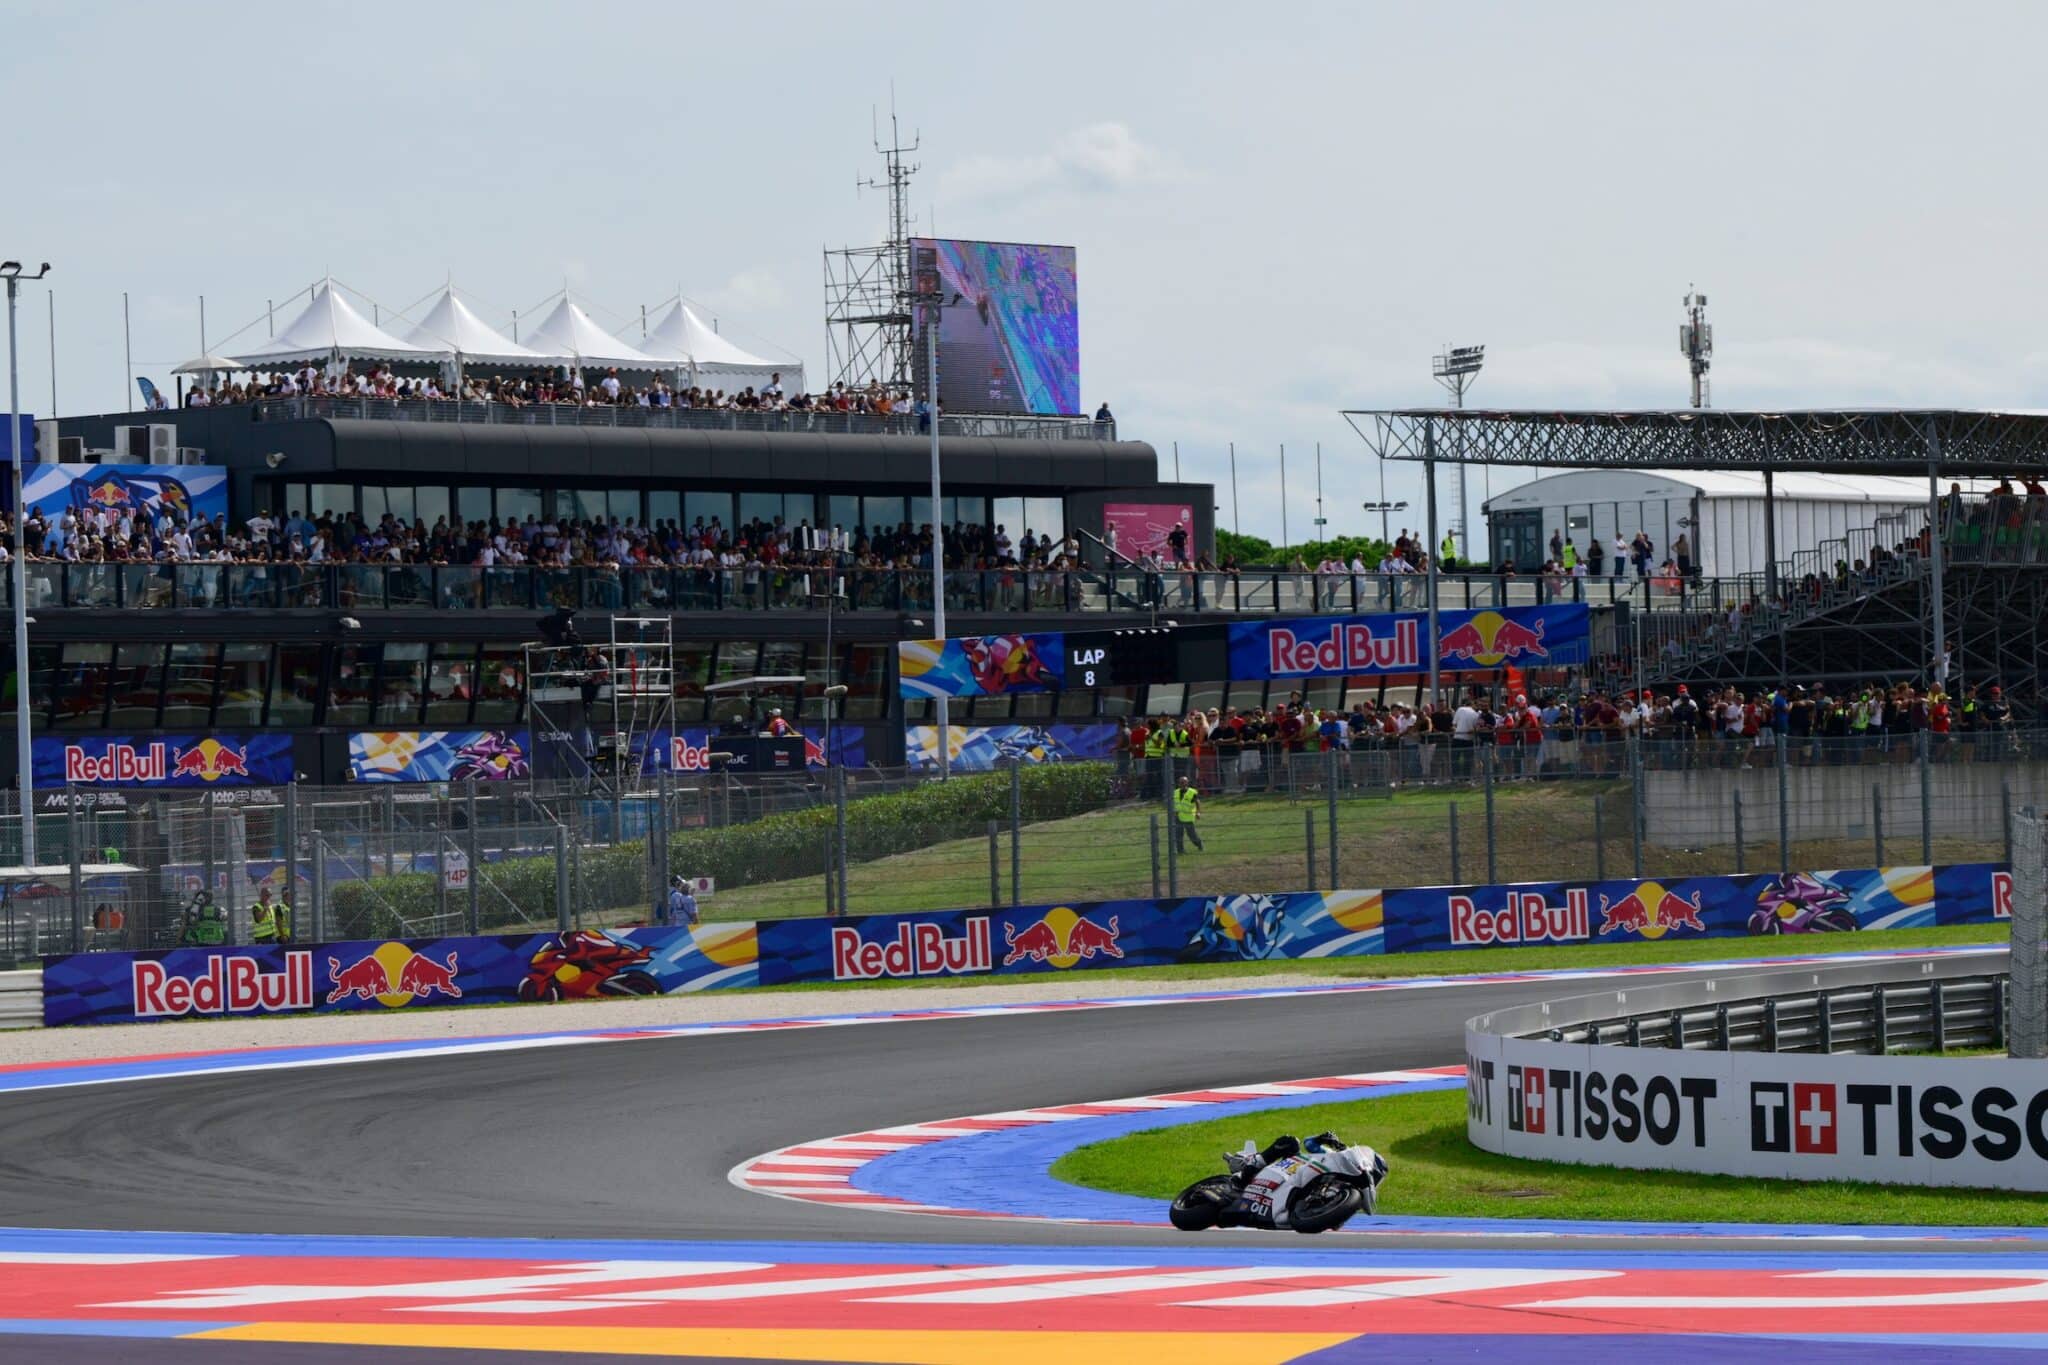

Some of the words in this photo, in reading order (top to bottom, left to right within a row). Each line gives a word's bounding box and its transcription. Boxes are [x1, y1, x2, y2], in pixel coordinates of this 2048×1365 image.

[1073, 649, 1105, 665] LAP
[1270, 623, 1344, 673] Red
[1346, 619, 1418, 669] Bull
[1084, 670, 1096, 686] 8
[66, 744, 116, 781] Red
[117, 743, 165, 780] Bull
[445, 869, 467, 883] 14P
[1449, 892, 1519, 944] Red
[1521, 889, 1589, 940] Bull
[833, 922, 913, 979] Red
[915, 917, 992, 974] Bull
[133, 955, 224, 1016] Red
[227, 951, 313, 1011] Bull
[1549, 1069, 1717, 1148] TISSOT
